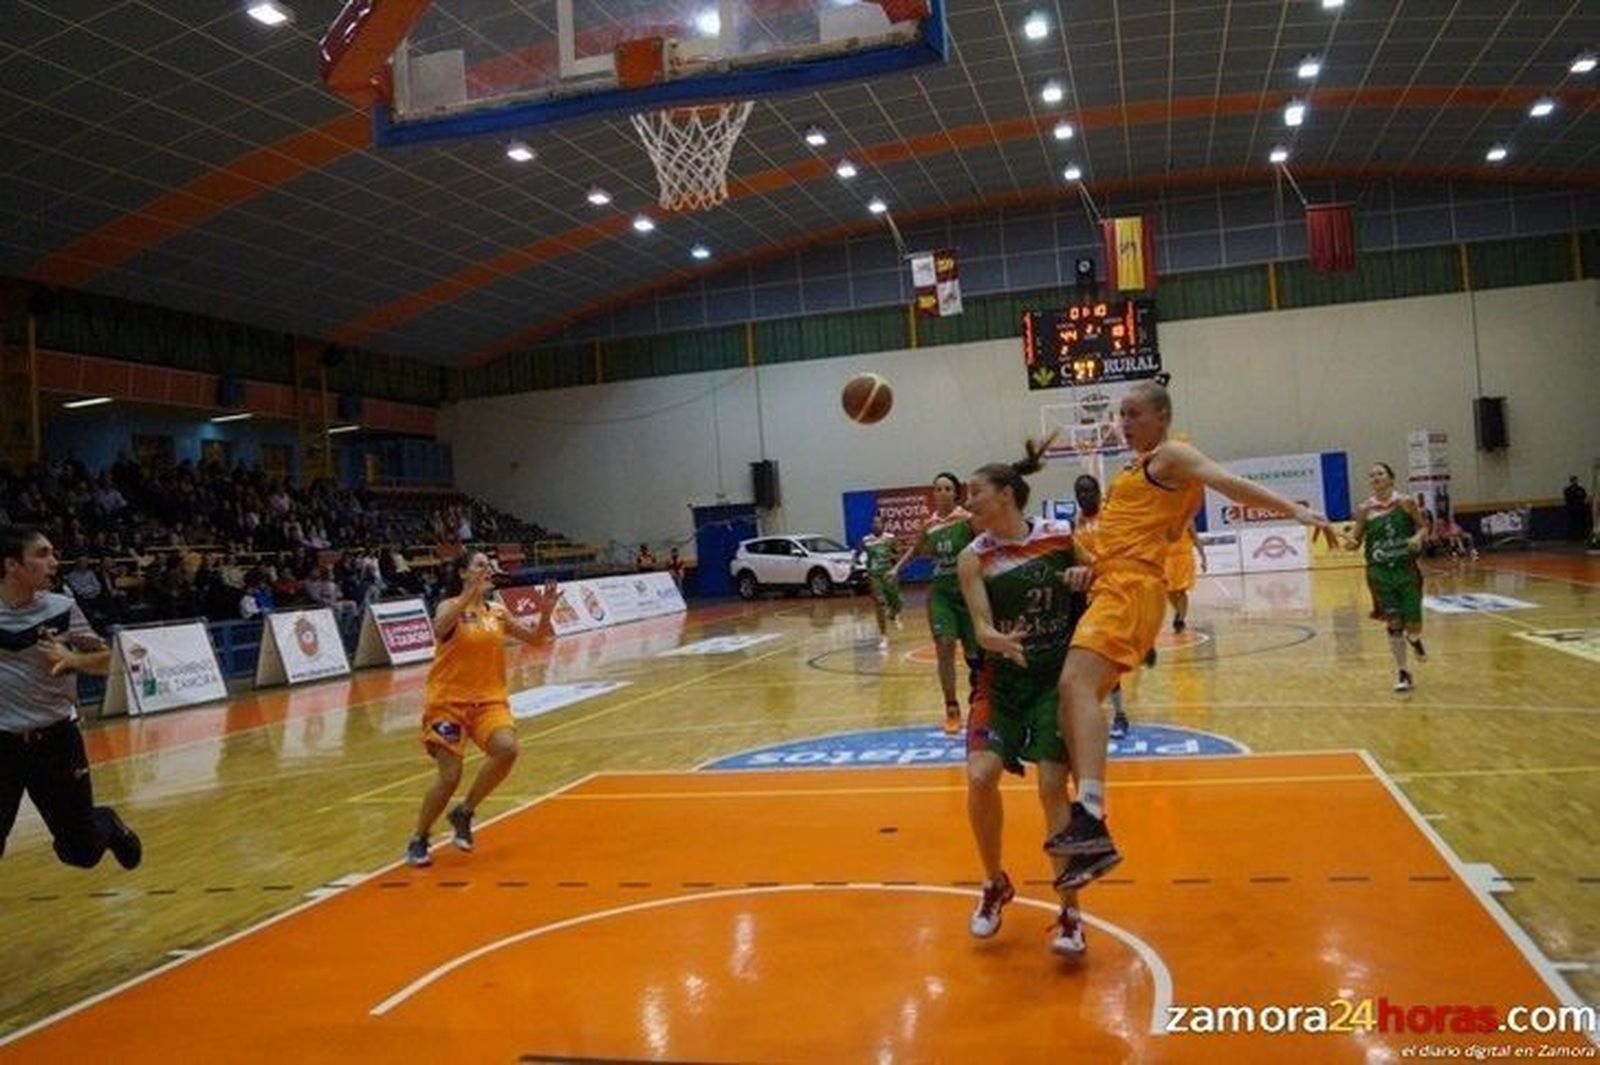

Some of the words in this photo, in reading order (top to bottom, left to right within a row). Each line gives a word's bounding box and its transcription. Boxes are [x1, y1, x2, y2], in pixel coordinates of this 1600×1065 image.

[1103, 355, 1158, 373] RURAL
[877, 505, 930, 518] TOYOTA
[1025, 587, 1053, 613] 21
